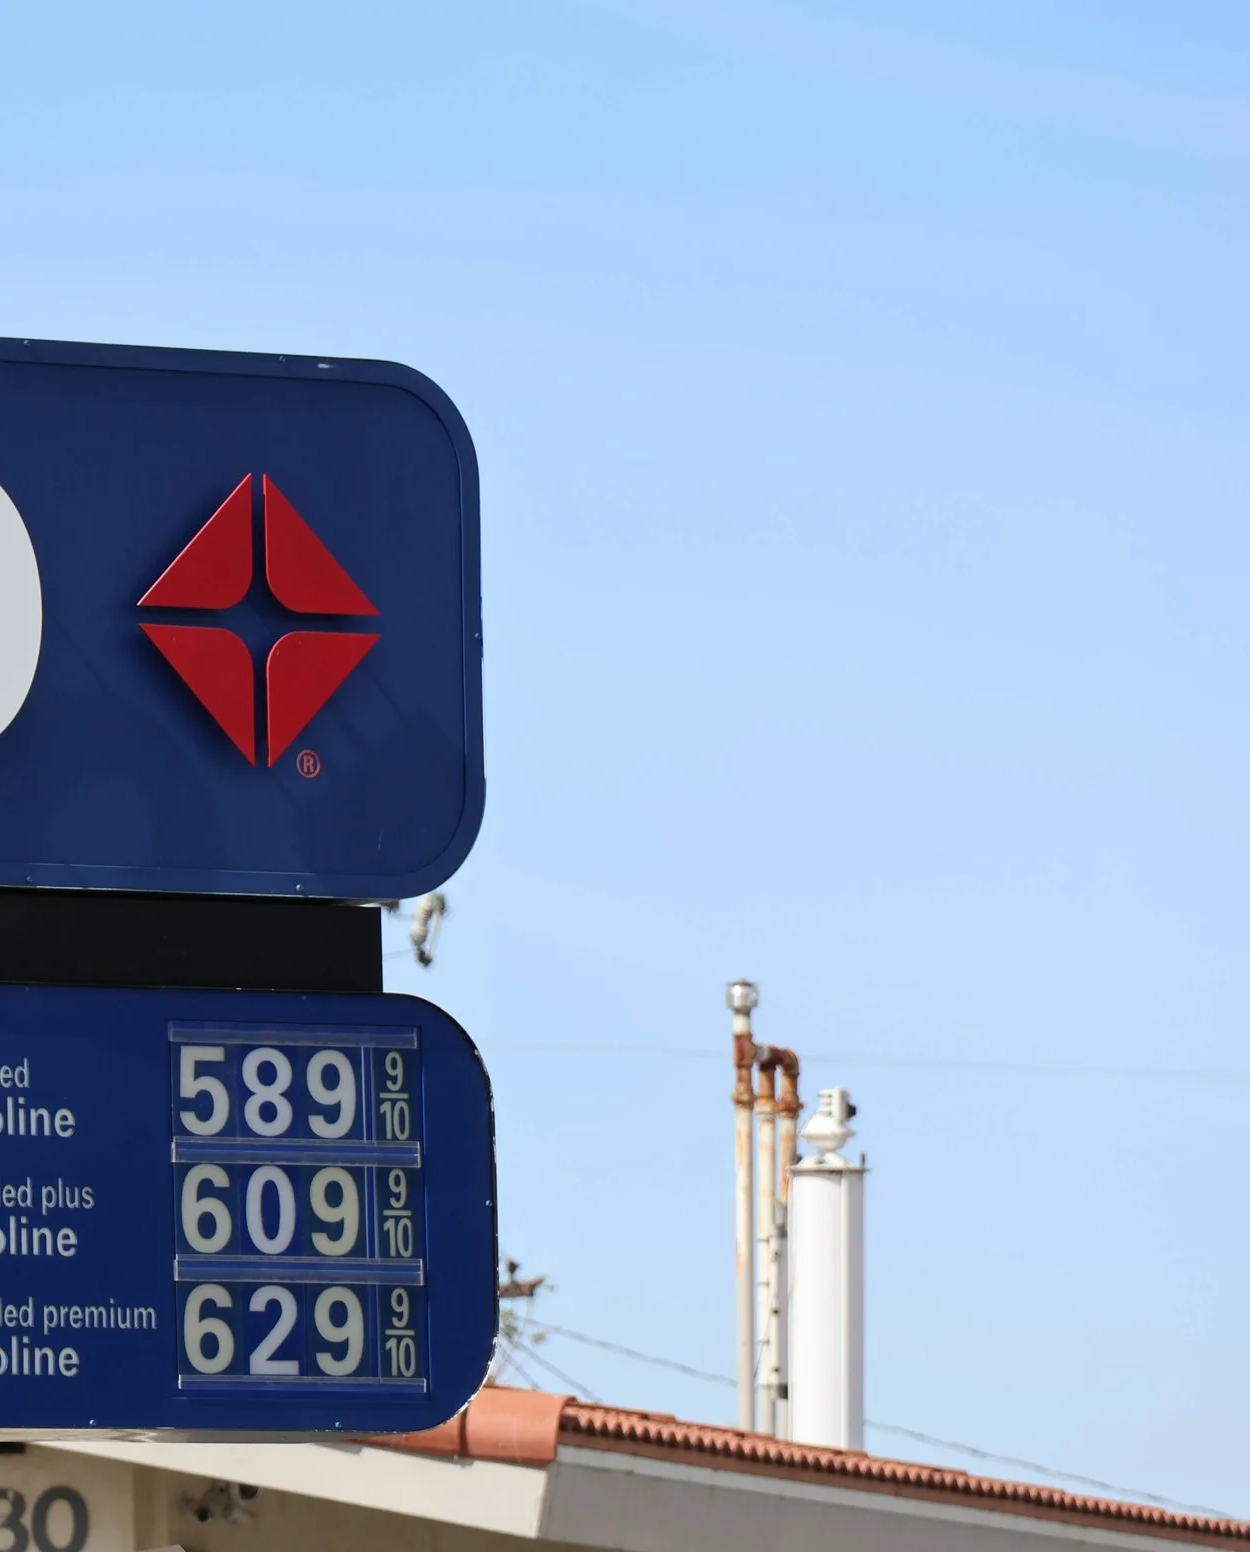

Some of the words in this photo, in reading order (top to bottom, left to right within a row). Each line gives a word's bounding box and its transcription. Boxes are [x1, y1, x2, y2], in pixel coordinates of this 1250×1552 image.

[386, 1053, 402, 1090] 9
[181, 1047, 355, 1138] 589
[381, 1101, 409, 1140] 10
[42, 1179, 93, 1214] plus
[389, 1170, 406, 1208] 9
[182, 1165, 358, 1255] 609
[384, 1218, 411, 1257] 10
[44, 1299, 155, 1334] premium
[392, 1289, 408, 1327] 9
[185, 1285, 363, 1375] 629
[386, 1338, 415, 1376] 10
